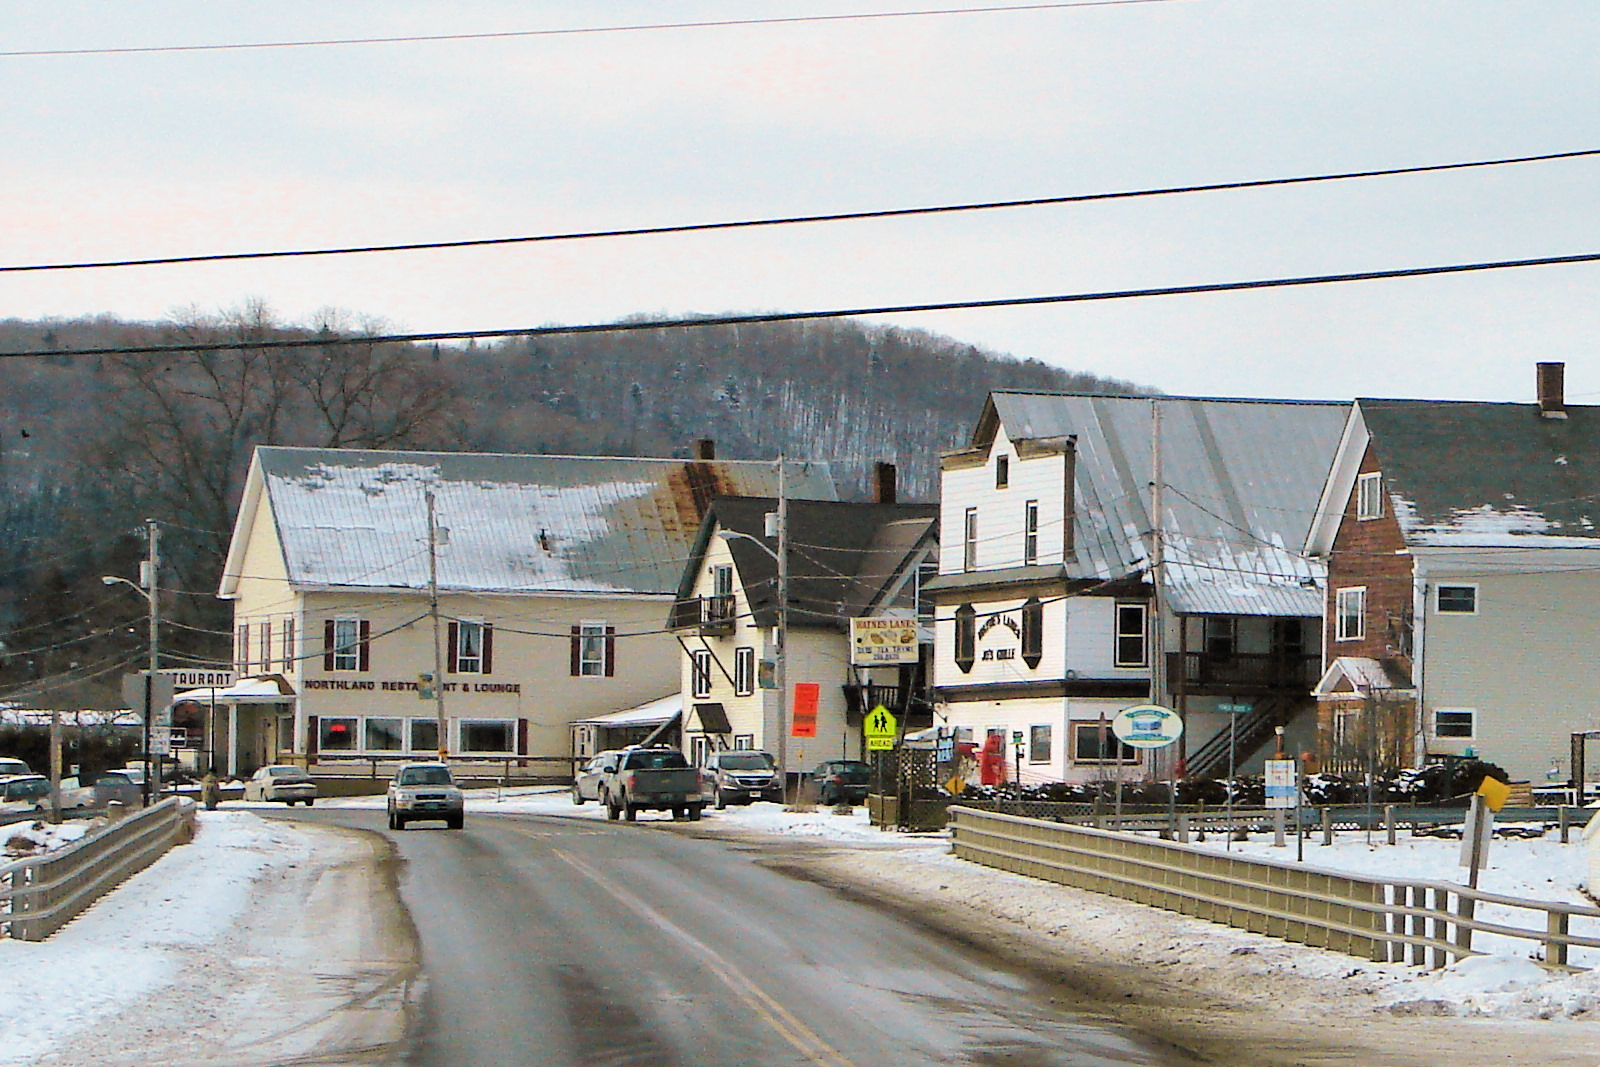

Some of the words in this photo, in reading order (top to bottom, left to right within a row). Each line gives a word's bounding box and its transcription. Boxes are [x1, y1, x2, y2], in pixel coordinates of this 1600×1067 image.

[157, 672, 231, 685] TAURANT
[304, 680, 375, 690] NORTHLAND
[382, 681, 457, 692] RESTANT
[463, 682, 470, 692] &
[475, 682, 521, 693] LOUNGE
